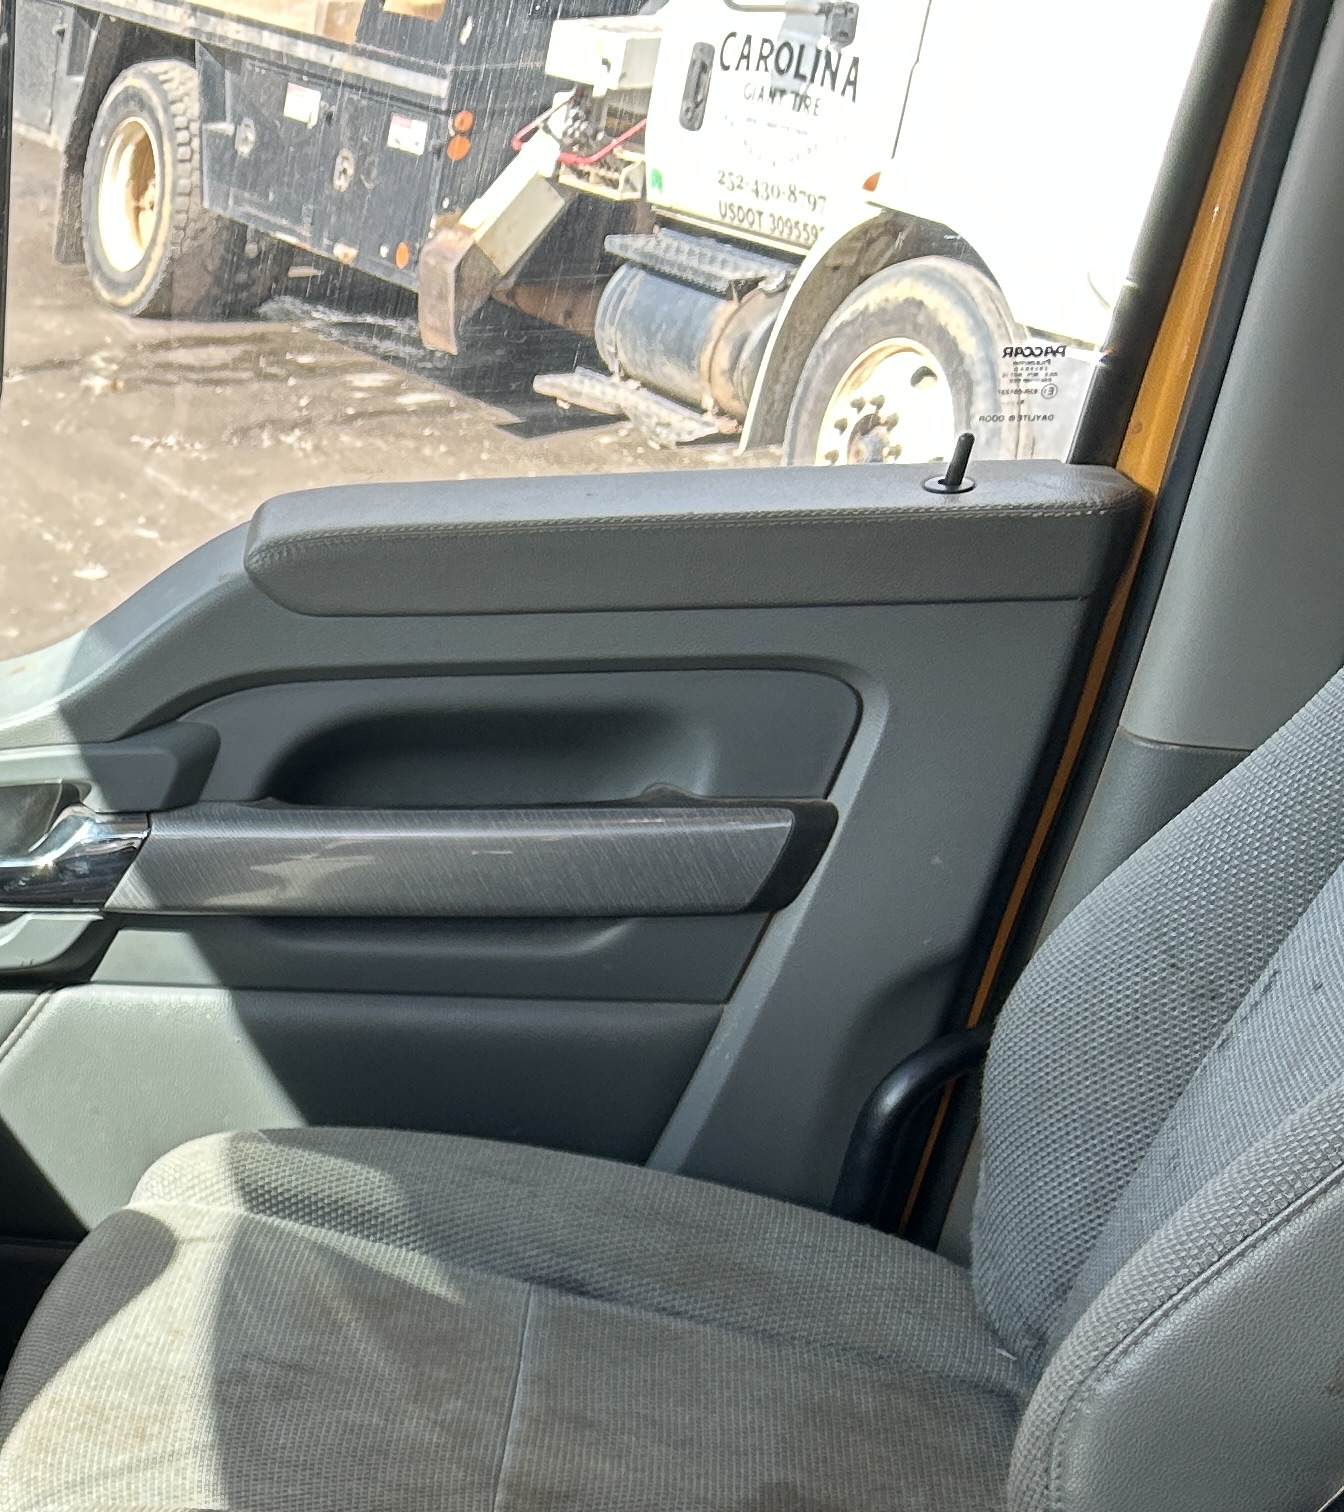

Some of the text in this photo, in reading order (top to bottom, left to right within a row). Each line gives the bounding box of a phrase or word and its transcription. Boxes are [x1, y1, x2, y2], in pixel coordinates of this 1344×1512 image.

[719, 31, 860, 103] CAROLINA
[743, 82, 822, 117] GIANT TIRE
[718, 200, 825, 242] USDOT 309559
